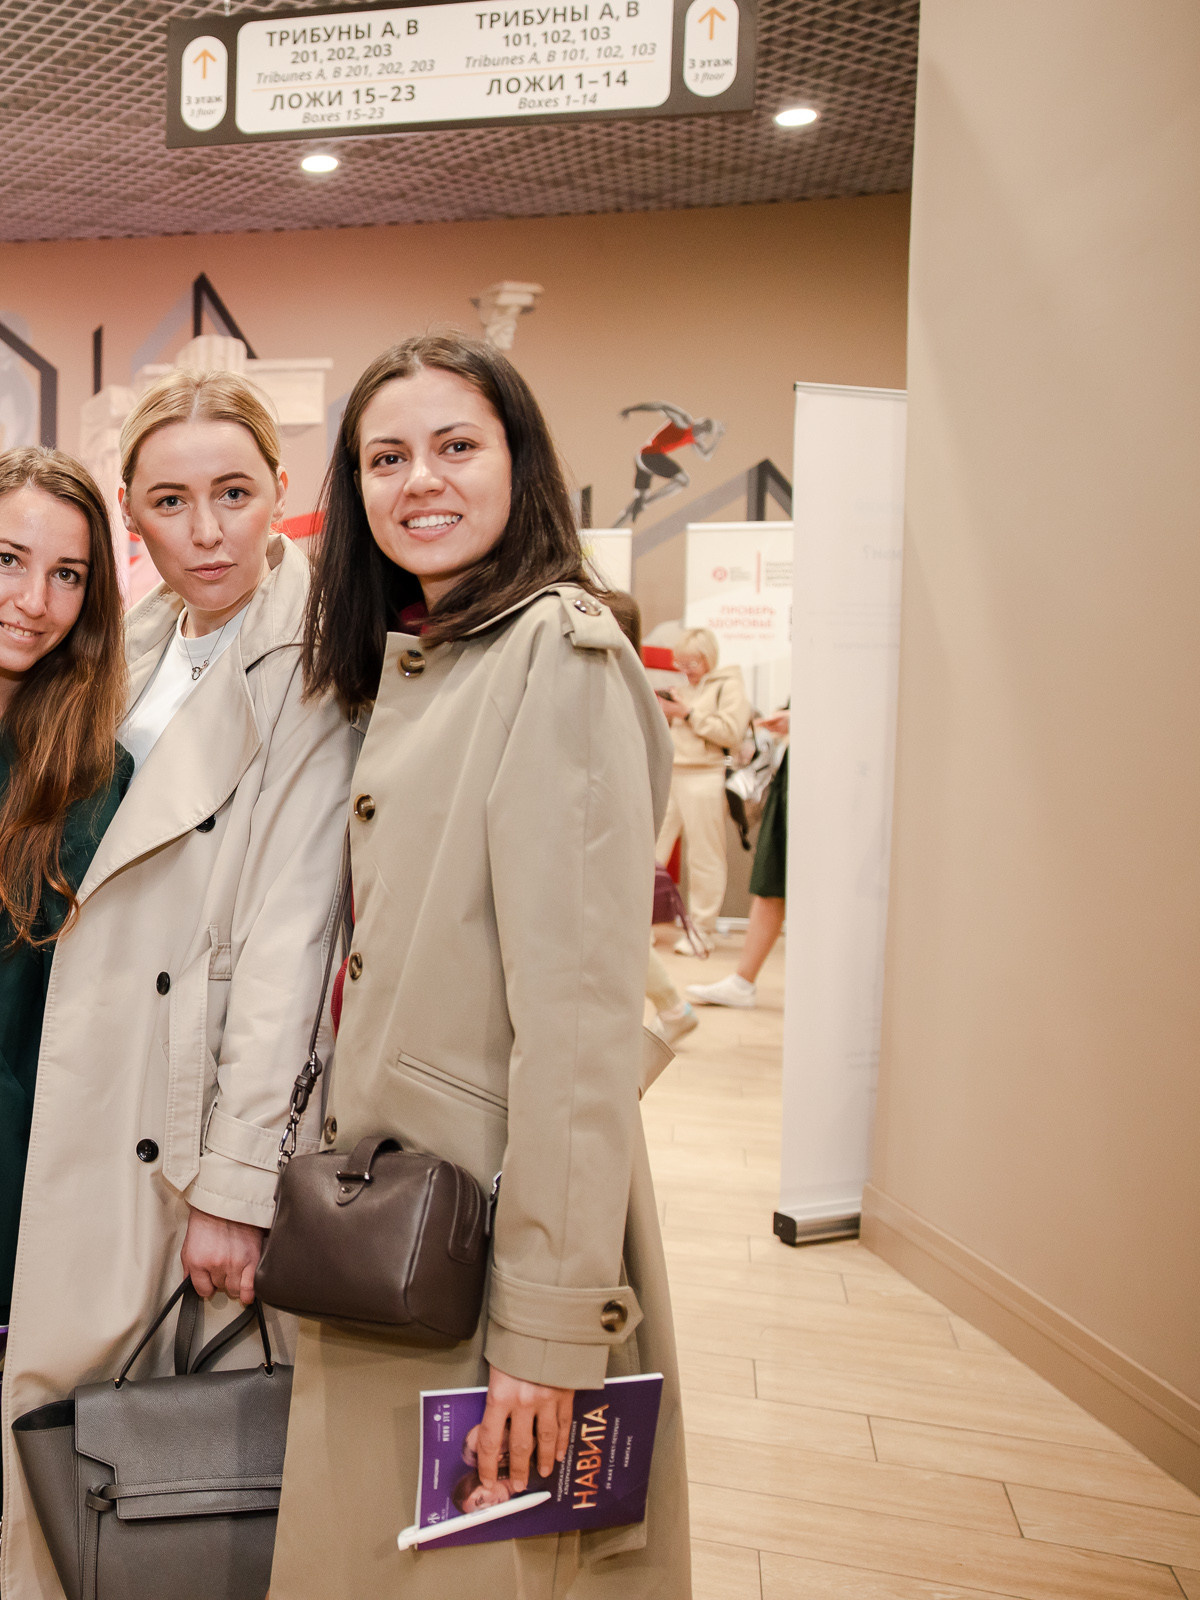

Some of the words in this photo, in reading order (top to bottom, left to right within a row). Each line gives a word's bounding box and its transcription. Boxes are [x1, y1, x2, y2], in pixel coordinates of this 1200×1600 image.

[475, 5, 589, 30] ТРИБУНЫ
[266, 23, 371, 47] ТРИБУНЫ
[503, 32, 537, 47] 101,
[541, 29, 575, 44] 102,
[581, 26, 611, 41] 103
[291, 50, 324, 65] 201,
[327, 46, 360, 61] 202,
[363, 43, 392, 58] 203
[464, 53, 524, 69] Tribunes
[561, 48, 590, 62] 101,
[596, 45, 625, 59] 102,
[631, 42, 657, 56] 103
[256, 70, 312, 85] Tribunes
[345, 64, 373, 78] 201,
[377, 61, 405, 76] 202,
[410, 59, 436, 73] 203
[486, 74, 565, 96] ЛОЖИ
[270, 90, 343, 110] ЛОЖИ
[518, 96, 559, 110] Boxes
[302, 111, 340, 124] Boxes
[572, 1403, 610, 1509] НАВИТА
